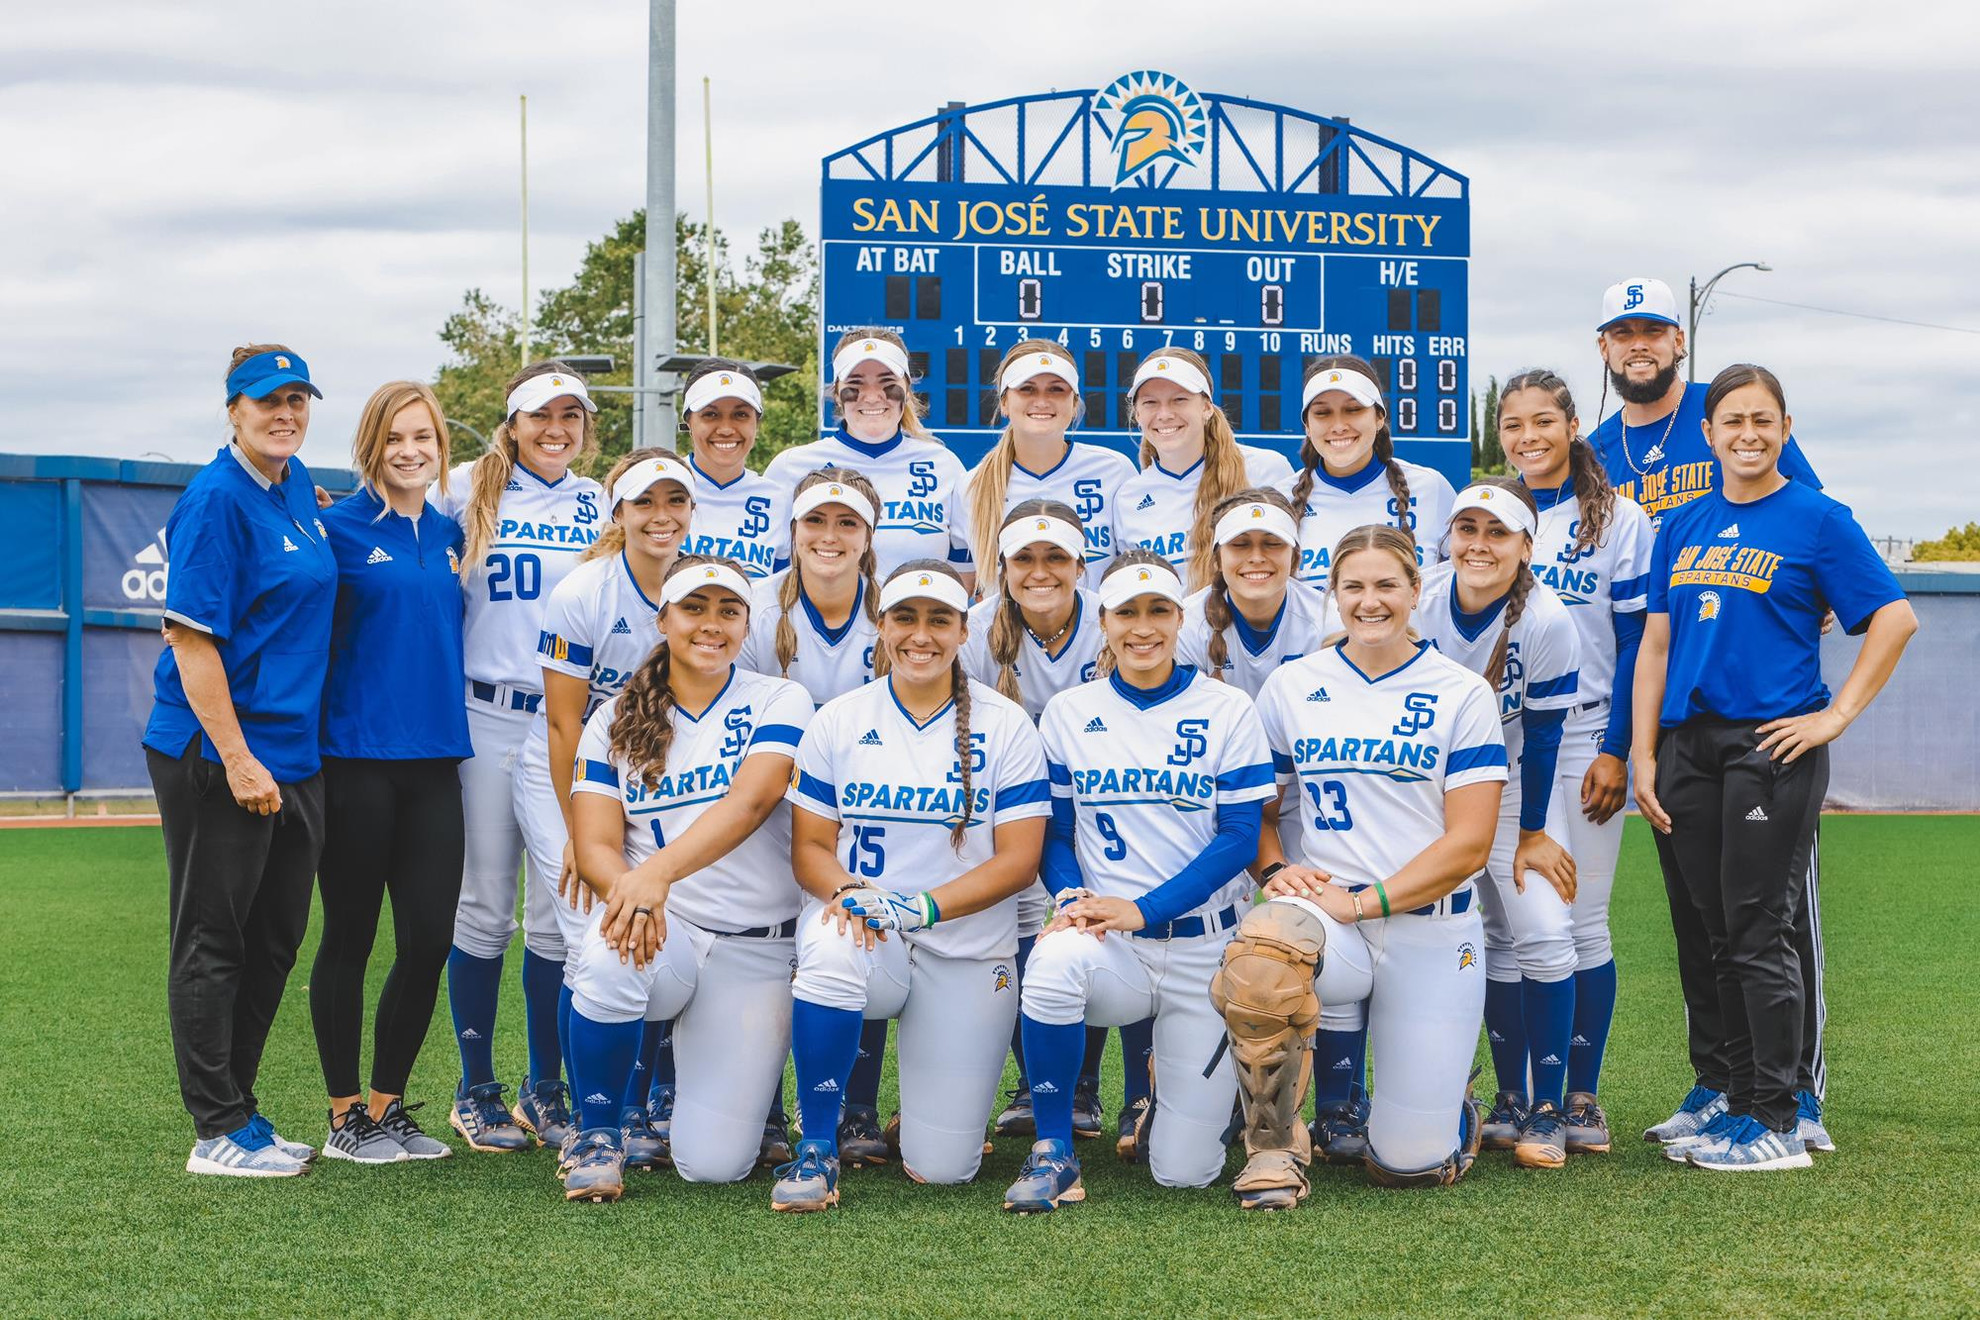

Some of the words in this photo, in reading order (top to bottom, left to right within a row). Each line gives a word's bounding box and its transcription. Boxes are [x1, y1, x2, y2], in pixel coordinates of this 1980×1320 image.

[852, 197, 940, 234] SAN
[952, 193, 1051, 240] JOSÉ
[1066, 203, 1185, 239] STATE
[1199, 207, 1441, 247] UNIVERSITY
[855, 247, 887, 272] AT
[894, 247, 940, 273] BAT
[1000, 250, 1062, 276] BALL
[1107, 253, 1192, 280] STRIKE
[1246, 257, 1296, 283] OUT
[1379, 261, 1419, 288] H/E
[1018, 278, 1042, 319] 0
[1141, 281, 1164, 322] 0
[1261, 284, 1284, 326] 0
[954, 325, 964, 346] 1
[984, 326, 997, 347] 2
[1057, 327, 1070, 347] 4
[1089, 328, 1102, 348] 5
[1122, 328, 1134, 349] 6
[1162, 329, 1174, 348] 7
[1193, 330, 1205, 351] 8
[1224, 331, 1236, 352] 9
[1259, 332, 1281, 353] 10
[1301, 333, 1353, 354] RUNS
[1373, 335, 1415, 356] HITS
[1428, 336, 1466, 357] ERR
[1398, 358, 1417, 391] 0
[1438, 359, 1457, 392] 0
[1398, 397, 1417, 430] 0
[1438, 398, 1457, 431] 0
[1671, 460, 1714, 494] STATE
[884, 500, 944, 523] TANS
[497, 518, 600, 545] PARTAN
[678, 534, 775, 568] ARTANS
[1672, 545, 1703, 573] SAN
[1694, 542, 1740, 571] JOSÉ
[1730, 547, 1785, 580] STATE
[485, 552, 541, 602] 20
[1531, 563, 1599, 595] TANS
[1678, 572, 1752, 588] SPARTANS
[1294, 737, 1440, 771] SPARTANS
[625, 757, 743, 804] SARTA
[841, 781, 990, 814] SPARTANS
[1073, 767, 1216, 799] SPARTANS
[1745, 813, 1769, 821] adidas
[849, 824, 886, 878] 15
[1095, 811, 1127, 861] 9
